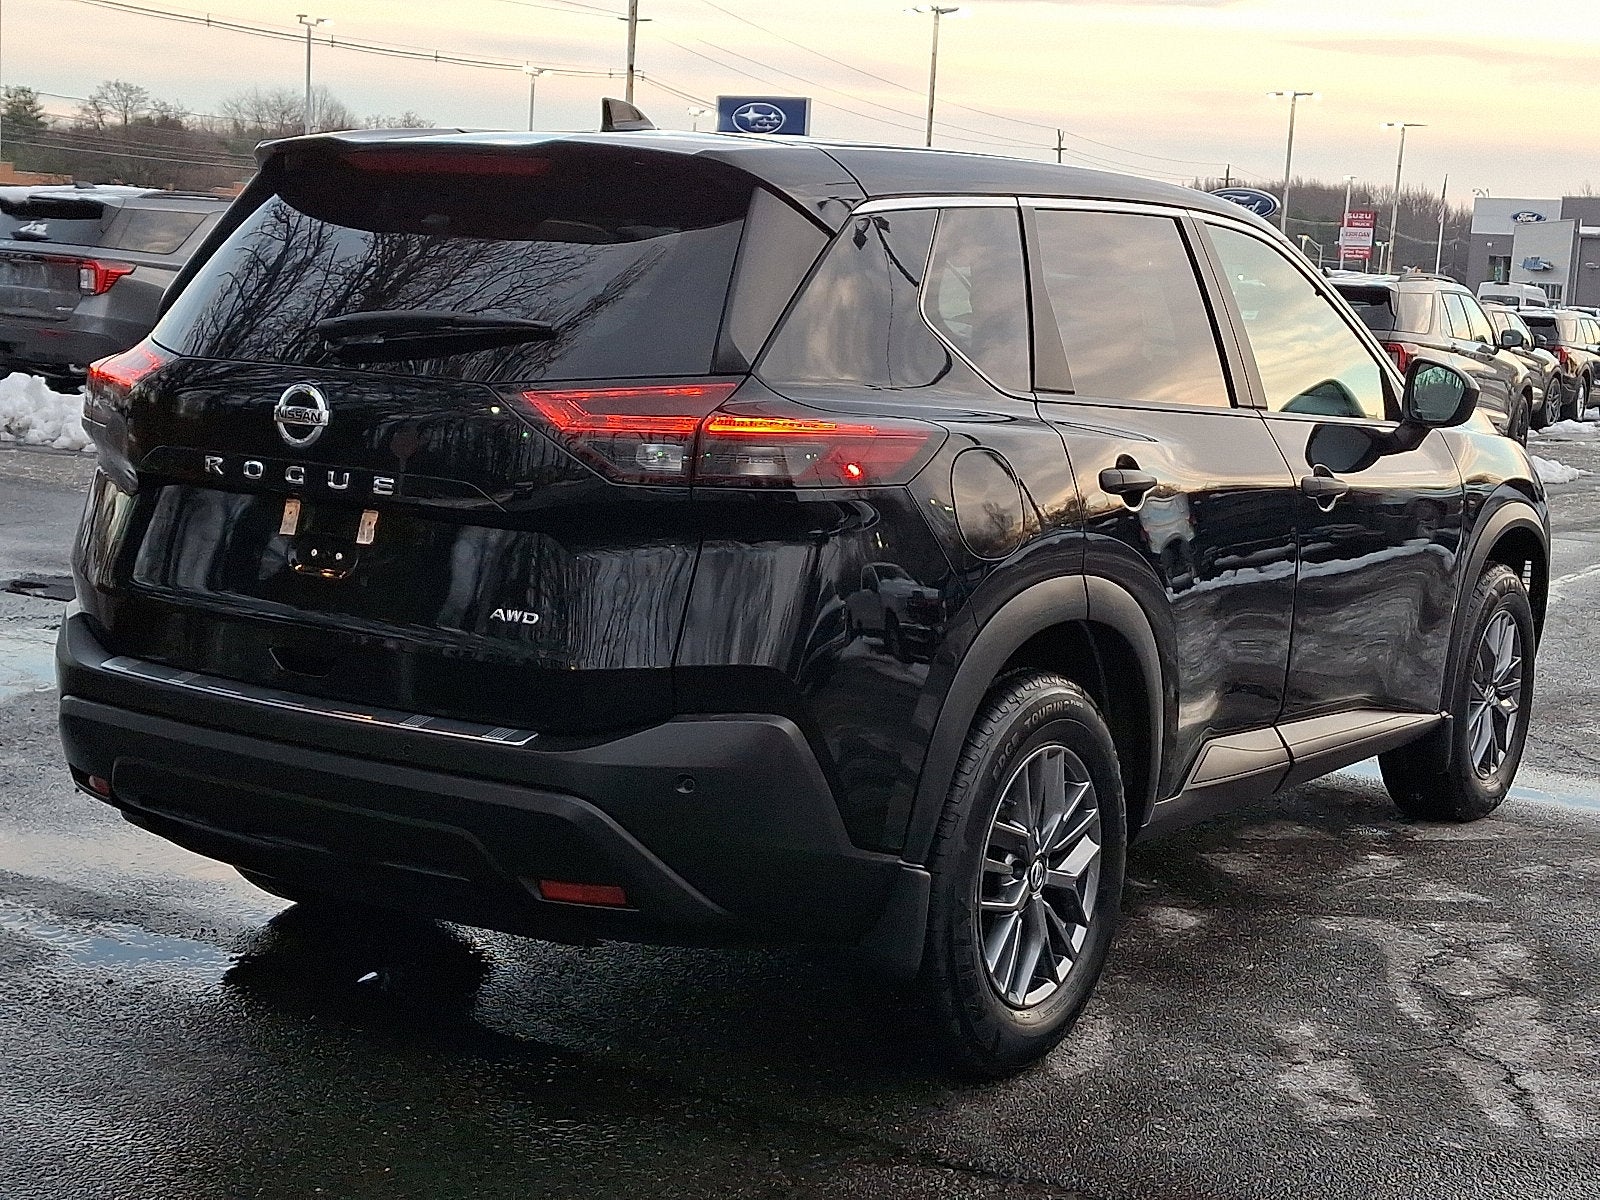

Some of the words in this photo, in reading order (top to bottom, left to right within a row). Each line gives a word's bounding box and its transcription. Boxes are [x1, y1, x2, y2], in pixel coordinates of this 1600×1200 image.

[280, 408, 322, 423] NISSAN
[204, 455, 395, 496] ROGUE
[489, 608, 540, 625] AWD
